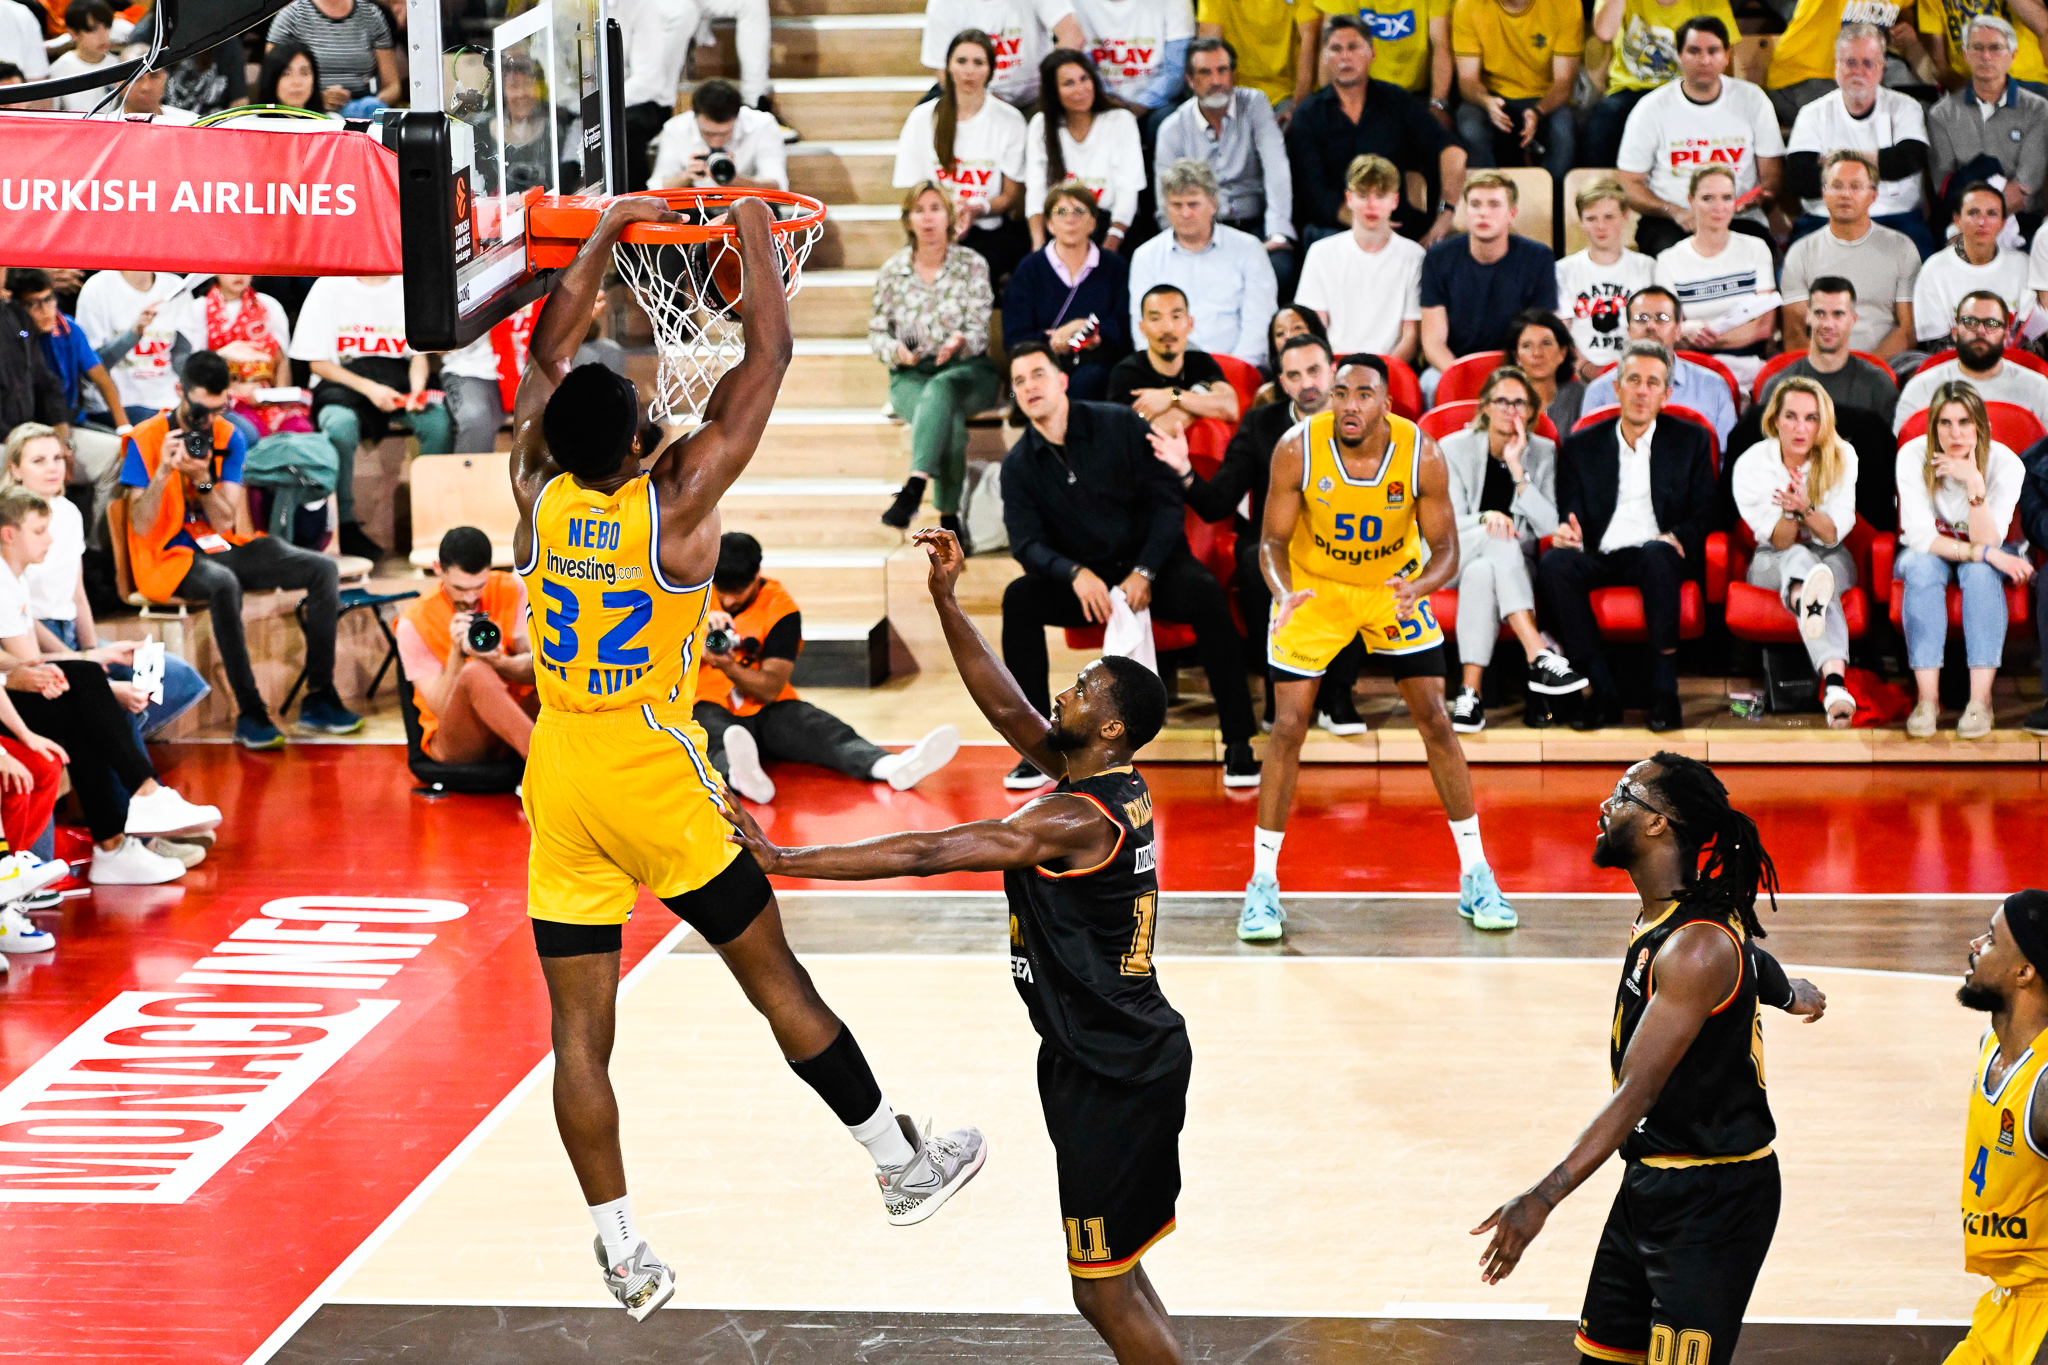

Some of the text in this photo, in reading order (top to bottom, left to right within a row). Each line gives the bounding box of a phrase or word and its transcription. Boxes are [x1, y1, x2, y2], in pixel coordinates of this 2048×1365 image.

[1092, 48, 1153, 65] PLAY
[1671, 147, 1745, 167] PLAY
[1, 178, 357, 216] URKISH AIRLINES
[134, 341, 171, 355] LAY
[337, 336, 408, 353] PLAY
[1589, 336, 1624, 350] APE
[568, 518, 621, 551] NEBO
[1334, 513, 1383, 543] 50
[546, 548, 643, 586] Investing.com
[541, 577, 653, 667] 32
[1398, 599, 1437, 640] 50
[0, 895, 470, 1193] MONACO INFO
[1968, 1145, 1990, 1198] 4
[1065, 1216, 1111, 1262] 11
